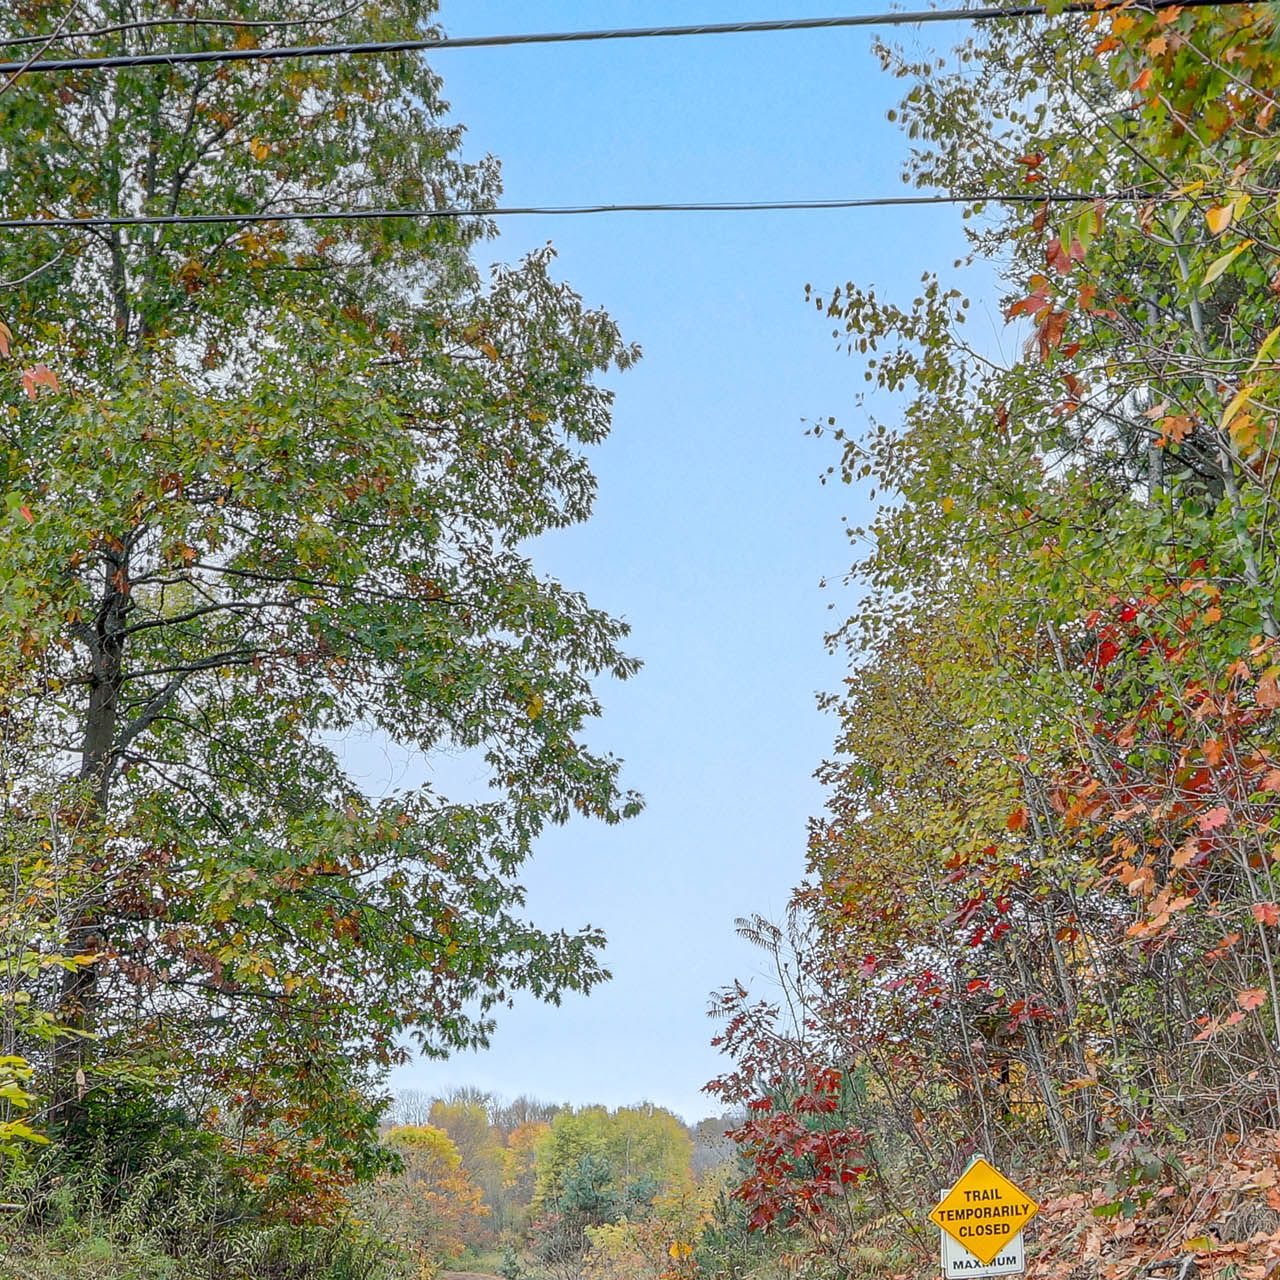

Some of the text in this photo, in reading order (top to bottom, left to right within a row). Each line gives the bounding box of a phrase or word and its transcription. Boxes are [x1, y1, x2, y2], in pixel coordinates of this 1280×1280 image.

[964, 1188, 1002, 1202] TRAIL
[938, 1204, 1030, 1222] TEMPORARILY
[959, 1223, 1010, 1238] CLOSED
[952, 1256, 1017, 1270] MAXMUM
